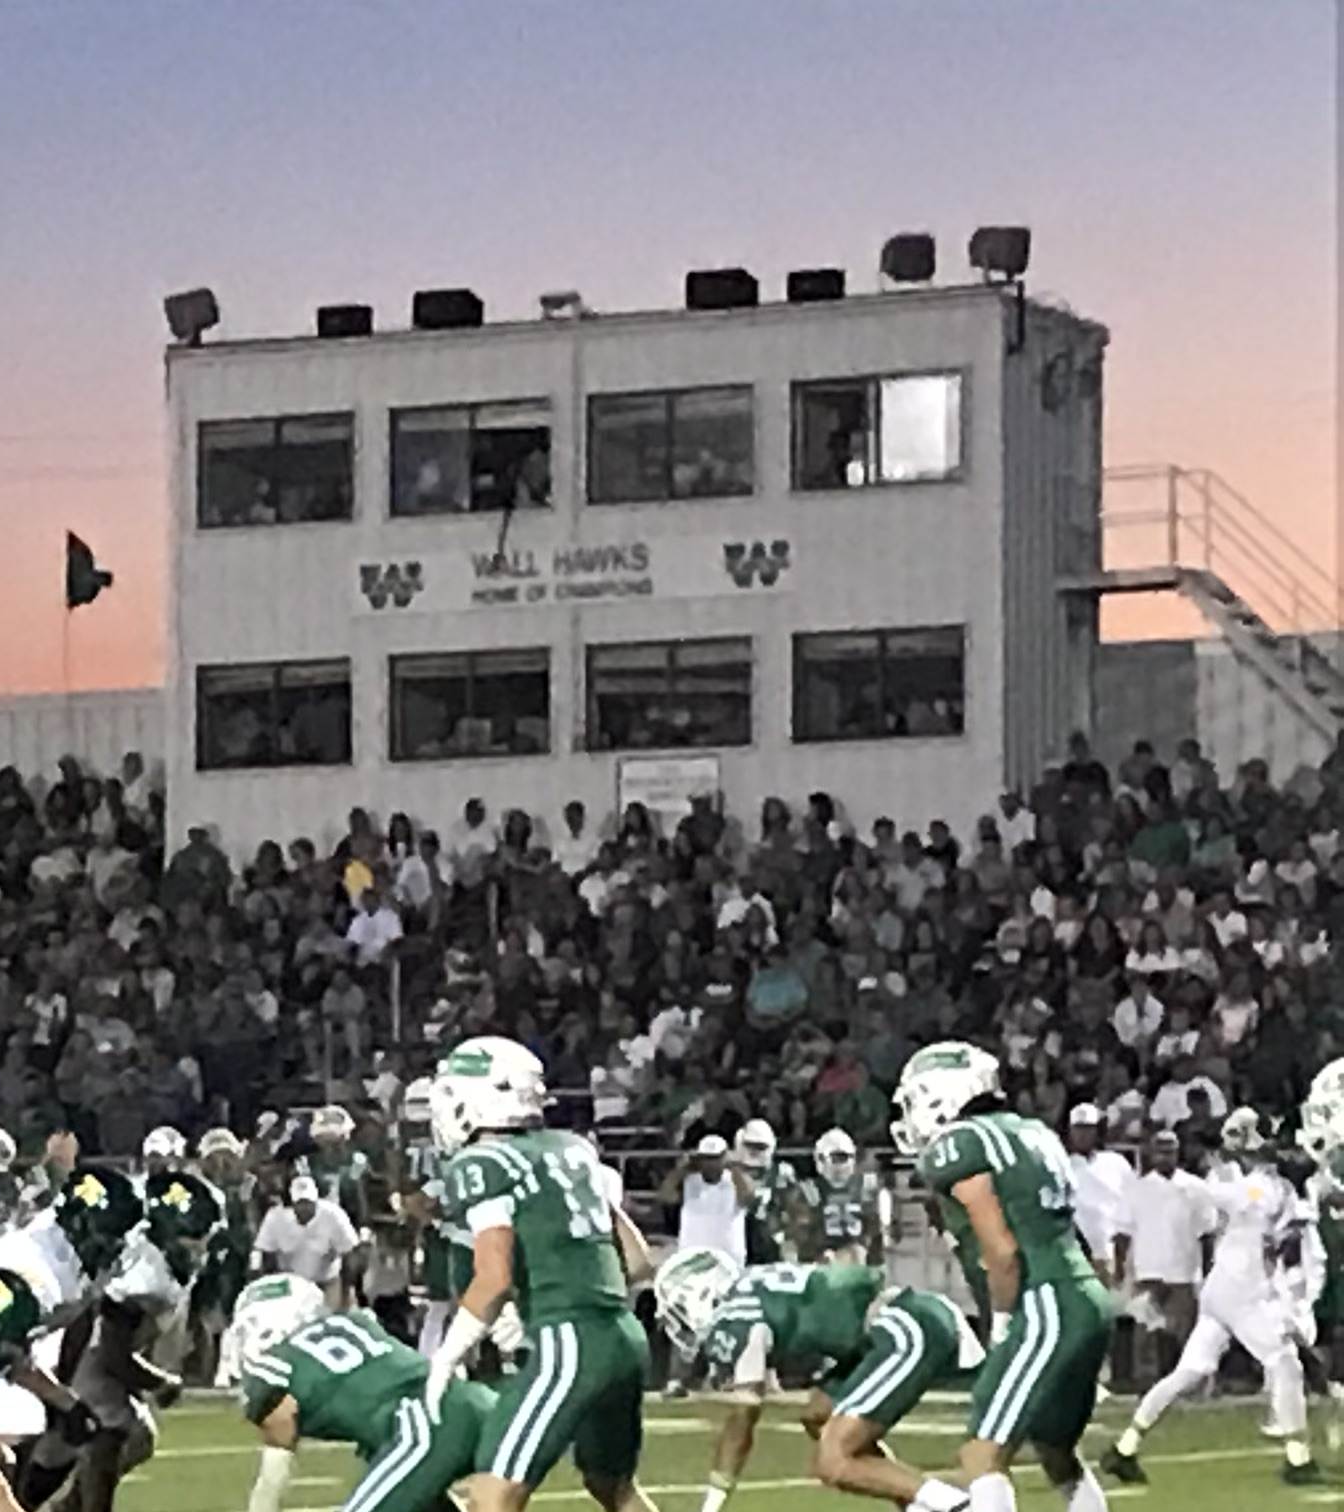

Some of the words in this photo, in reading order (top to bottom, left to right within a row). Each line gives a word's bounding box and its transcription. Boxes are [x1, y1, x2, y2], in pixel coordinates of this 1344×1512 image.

[471, 550, 540, 579] WALL
[553, 542, 651, 575] HAWKS
[453, 1164, 486, 1200] 13
[823, 1203, 863, 1237] 25
[289, 1315, 393, 1374] 61
